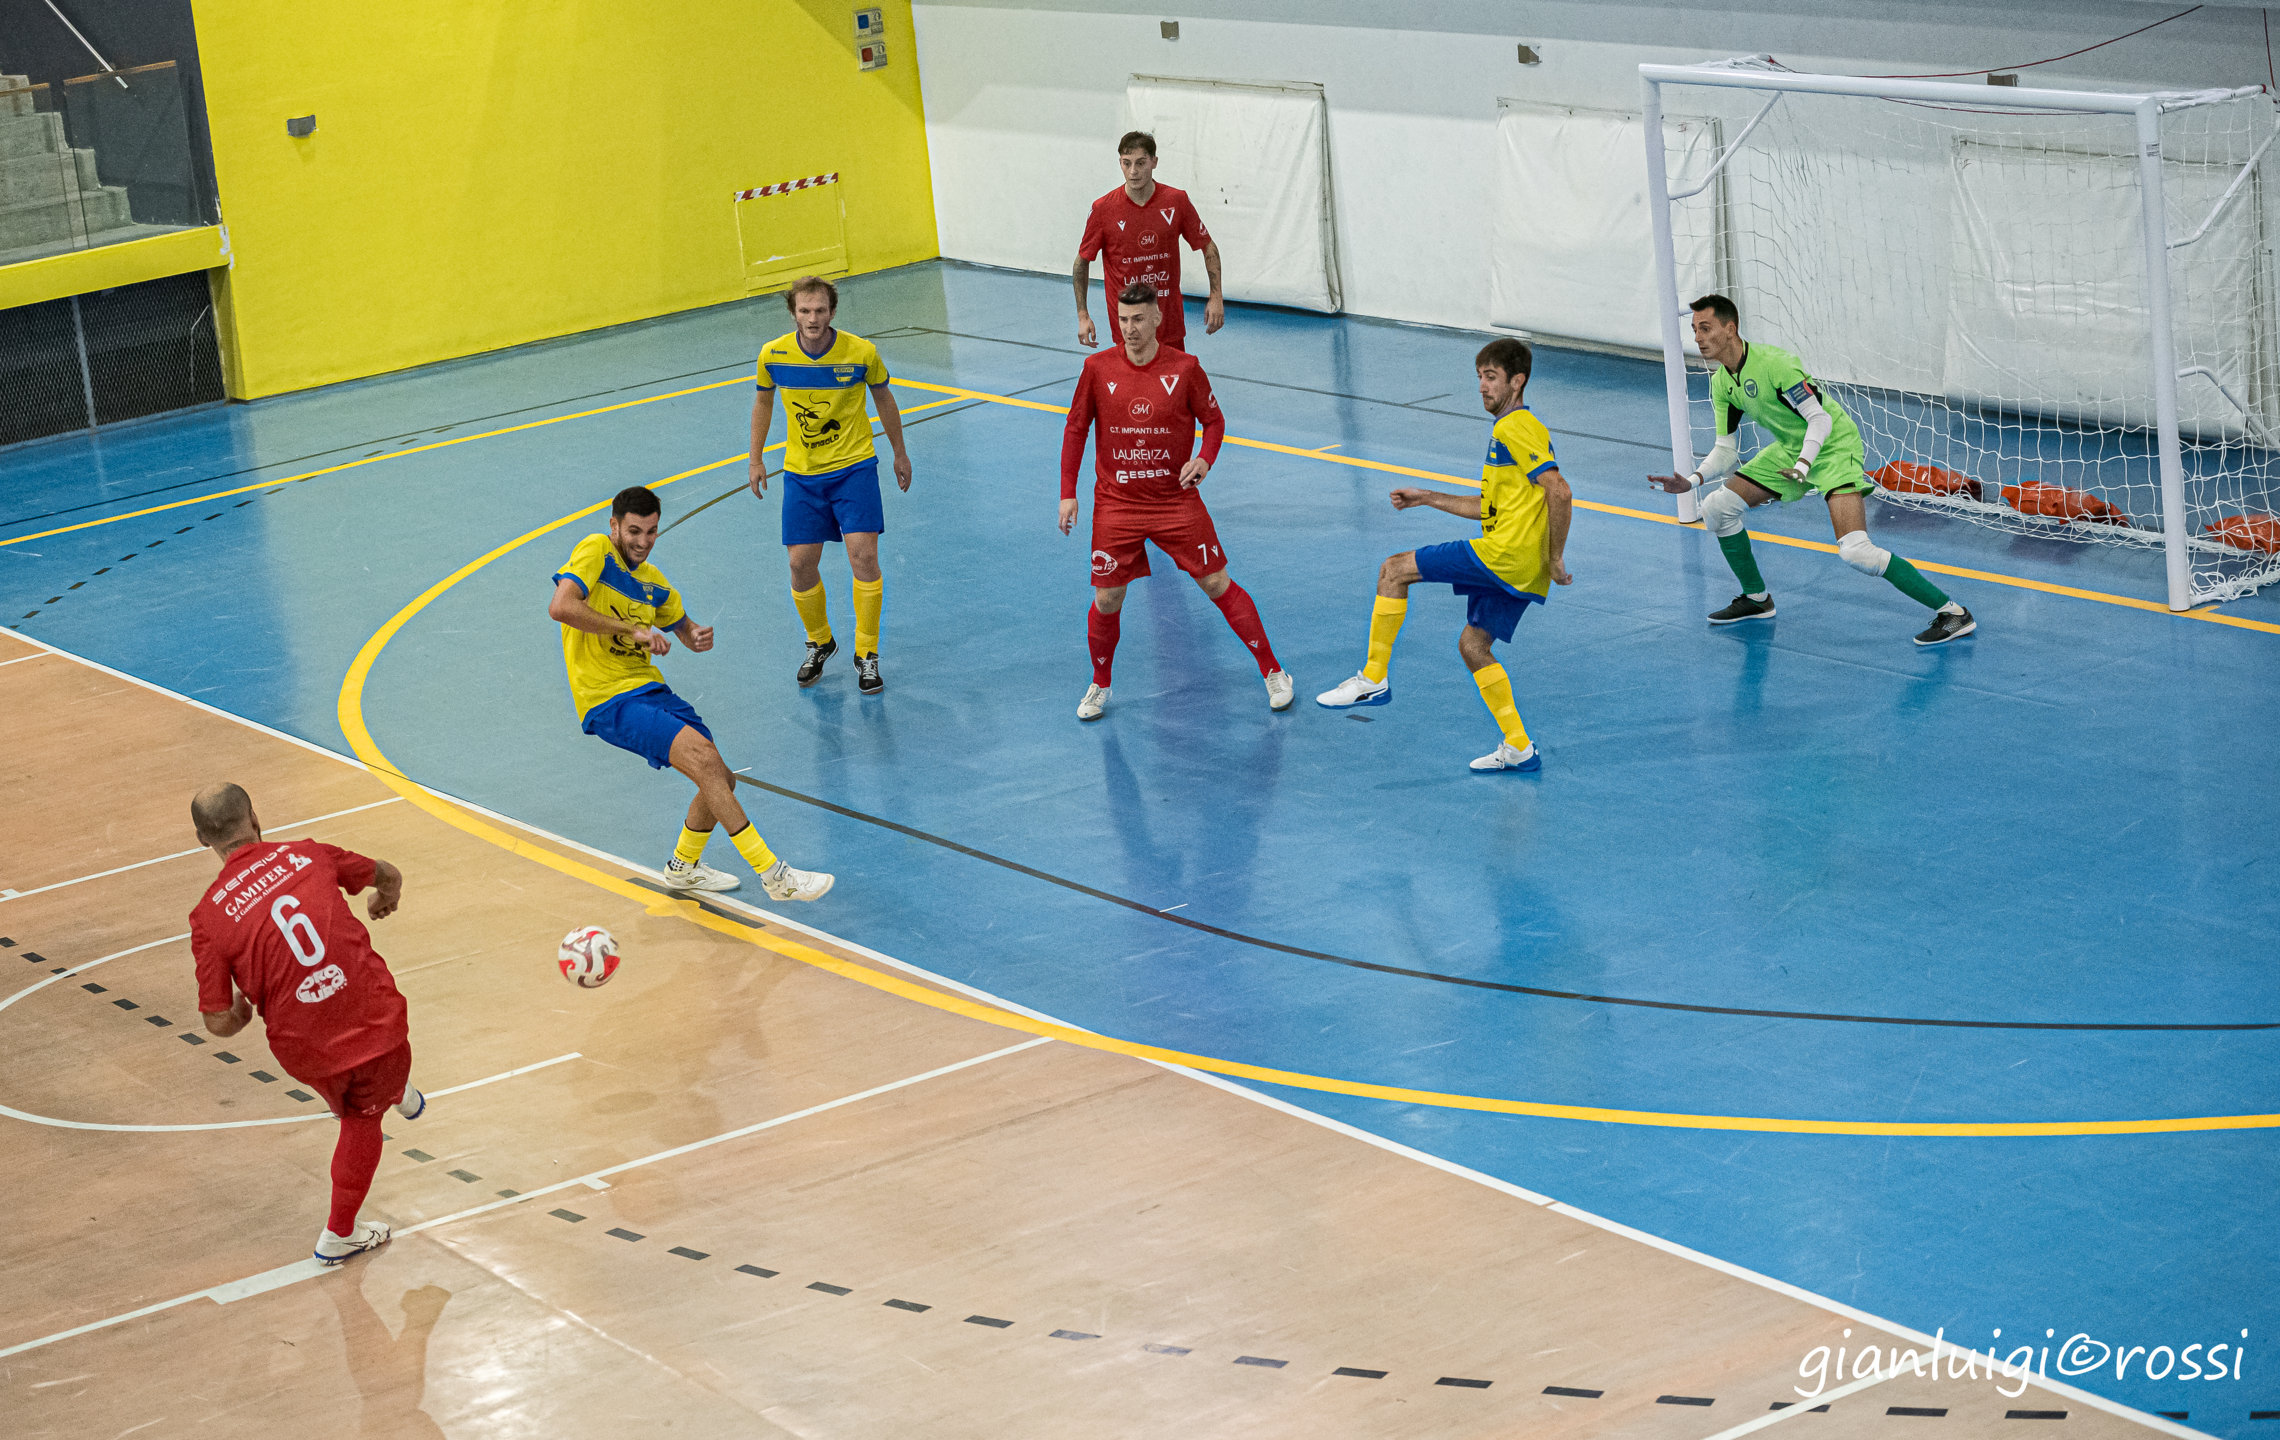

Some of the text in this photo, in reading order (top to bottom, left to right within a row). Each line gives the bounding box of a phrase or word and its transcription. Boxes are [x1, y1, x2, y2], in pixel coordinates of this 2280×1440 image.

[1121, 427, 1153, 435] IMPIANTI
[1197, 543, 1208, 566] 7
[224, 865, 288, 917] GAMIFER
[270, 894, 326, 967] 6
